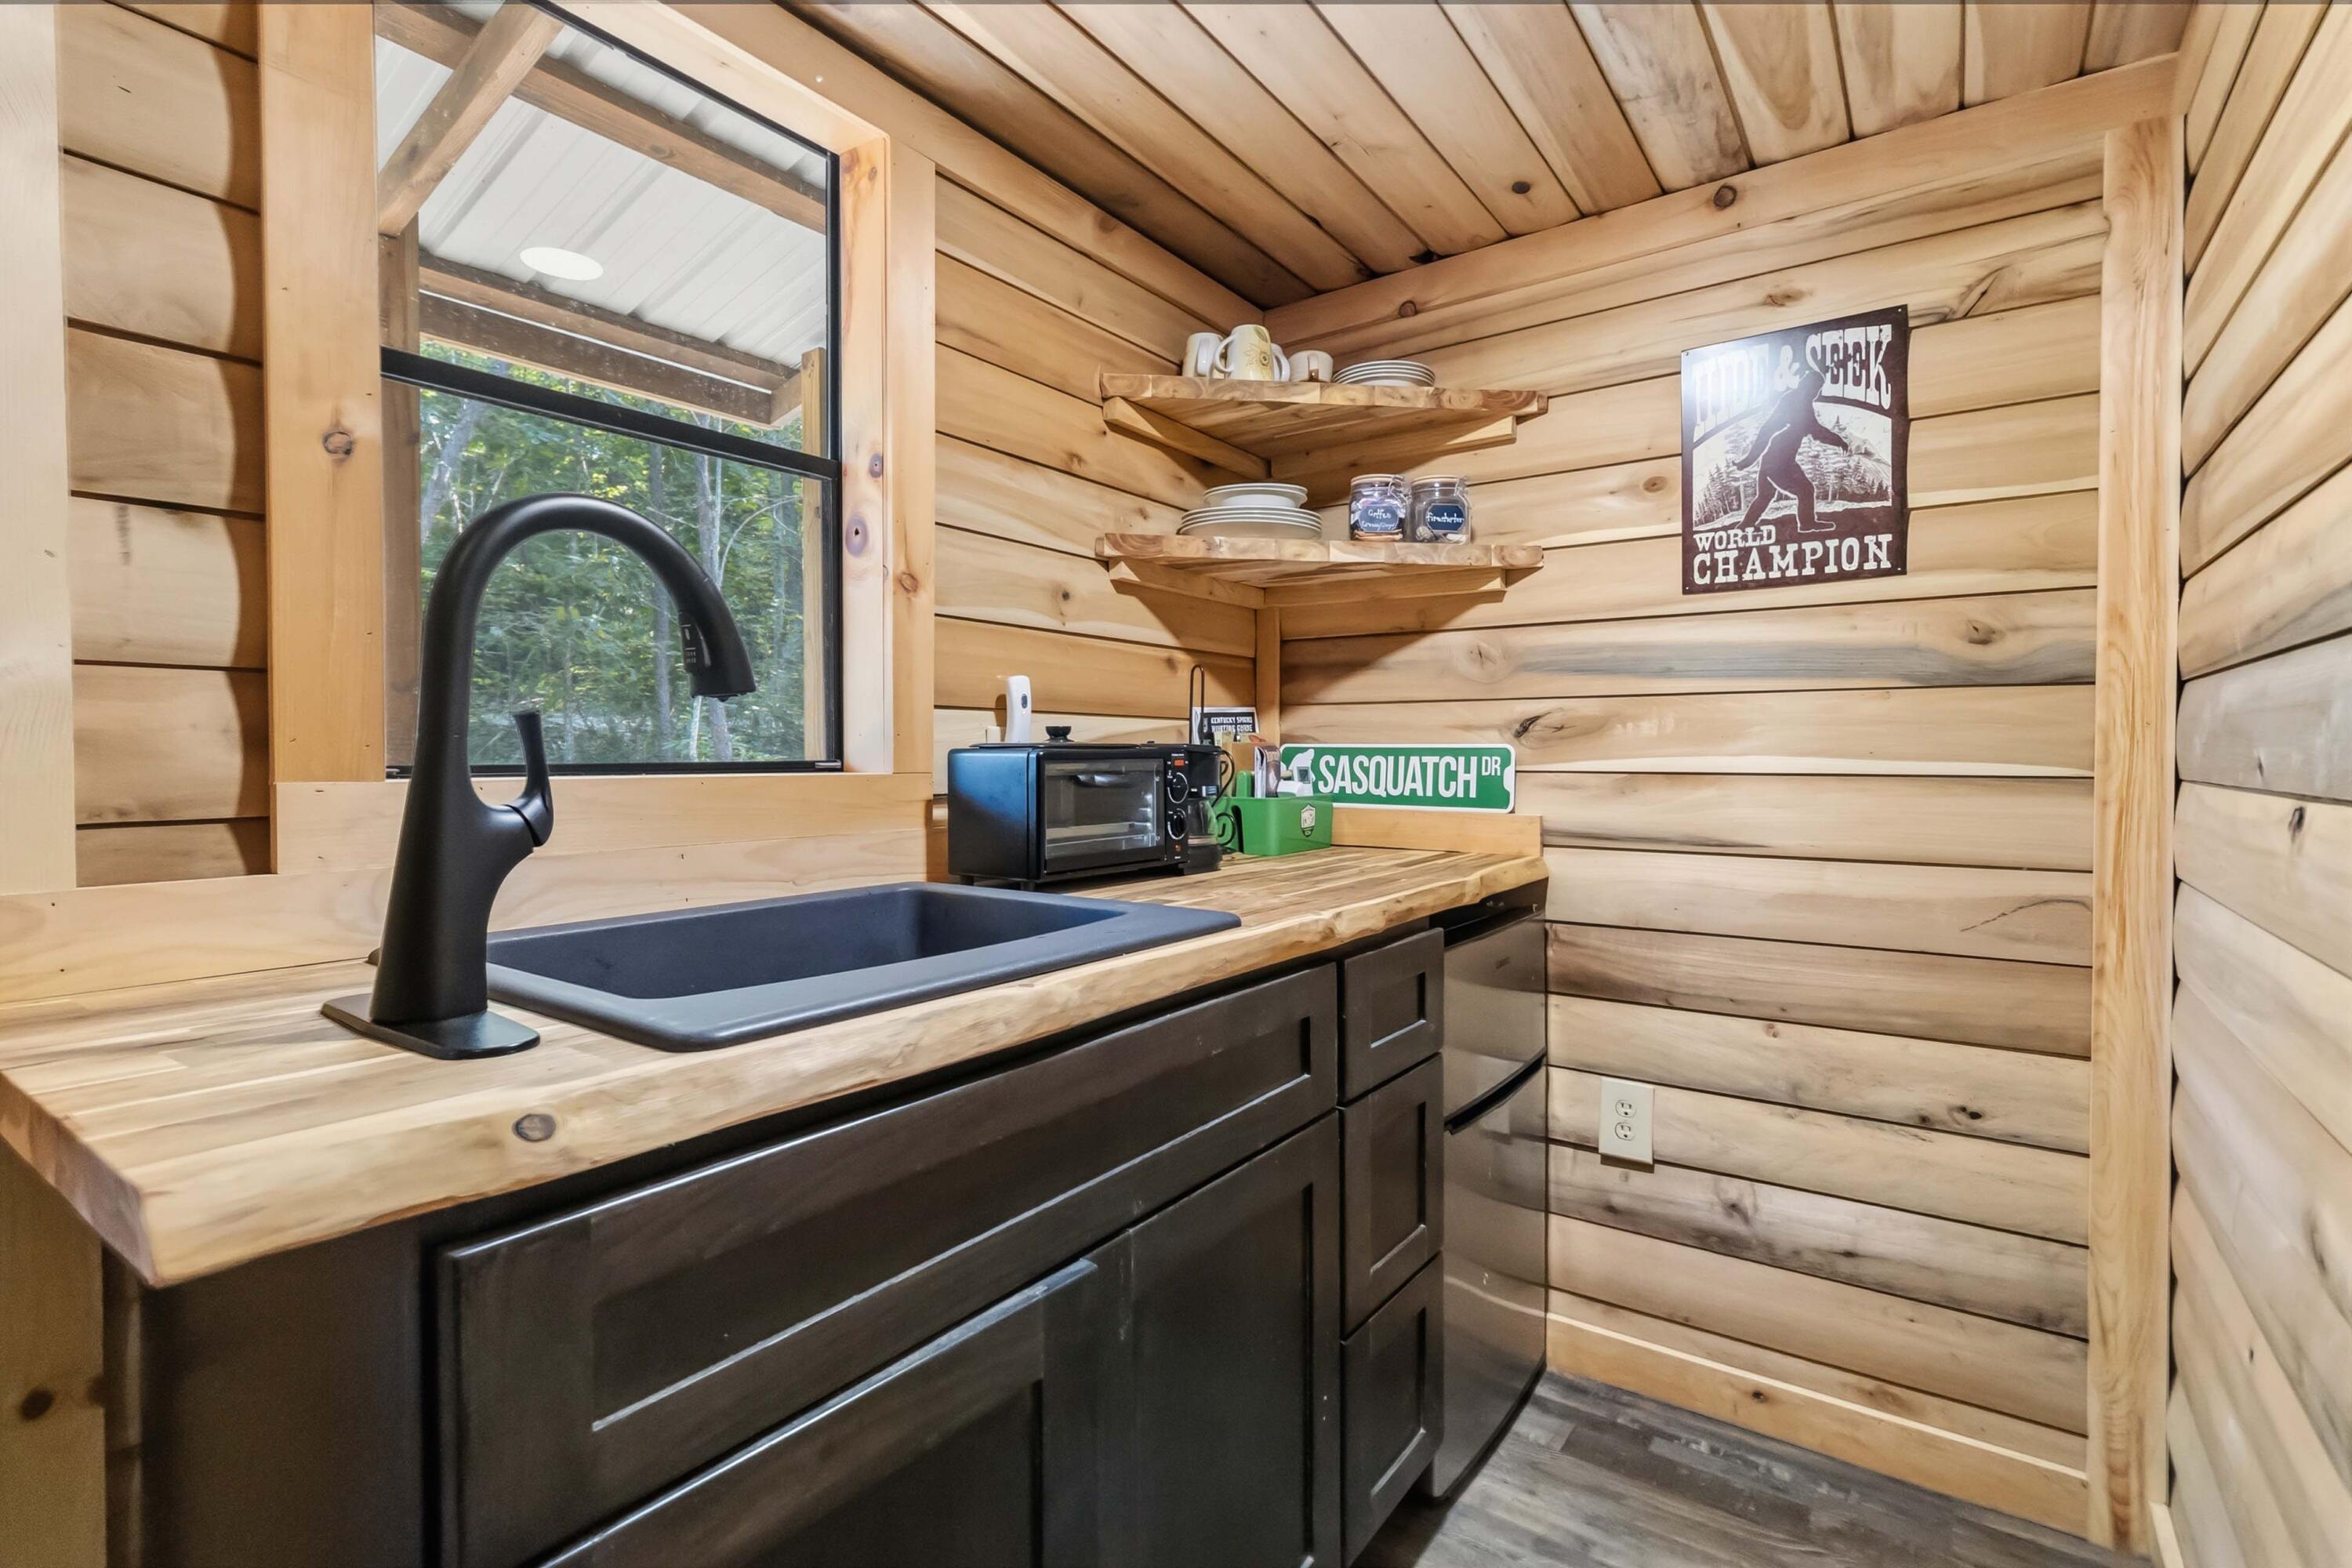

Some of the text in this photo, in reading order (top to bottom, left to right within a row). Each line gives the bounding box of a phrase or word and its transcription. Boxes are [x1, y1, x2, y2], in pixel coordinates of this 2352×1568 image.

[1773, 344, 1801, 392] &
[1806, 323, 1893, 410] SEEK
[1693, 524, 1777, 552] WORLD
[1693, 533, 1893, 585] CHAMPION
[1317, 754, 1501, 799] SASQUATCH DR
